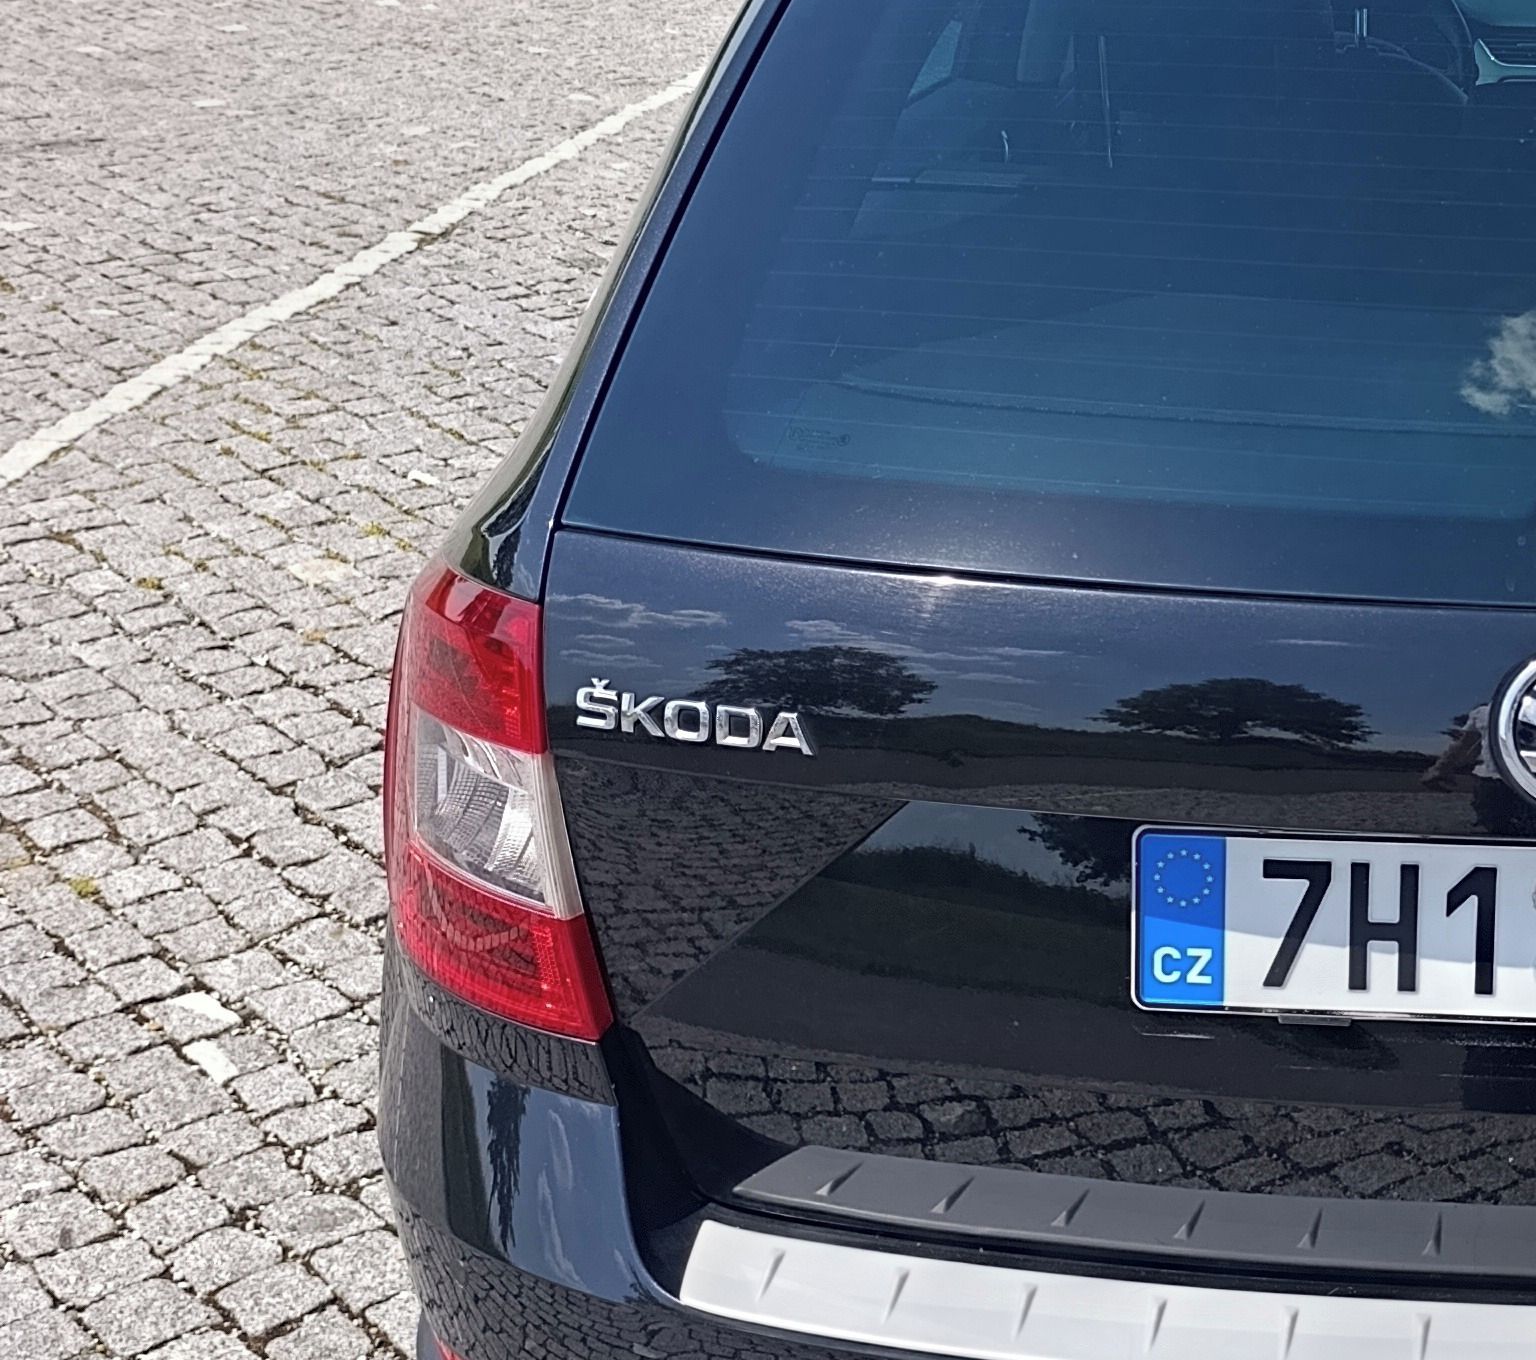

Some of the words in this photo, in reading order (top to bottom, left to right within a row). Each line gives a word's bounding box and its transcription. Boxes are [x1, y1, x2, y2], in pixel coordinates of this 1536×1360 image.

[576, 677, 815, 756] ŠKODA
[1152, 945, 1213, 986] CZ
[1261, 858, 1498, 997] 7H1
